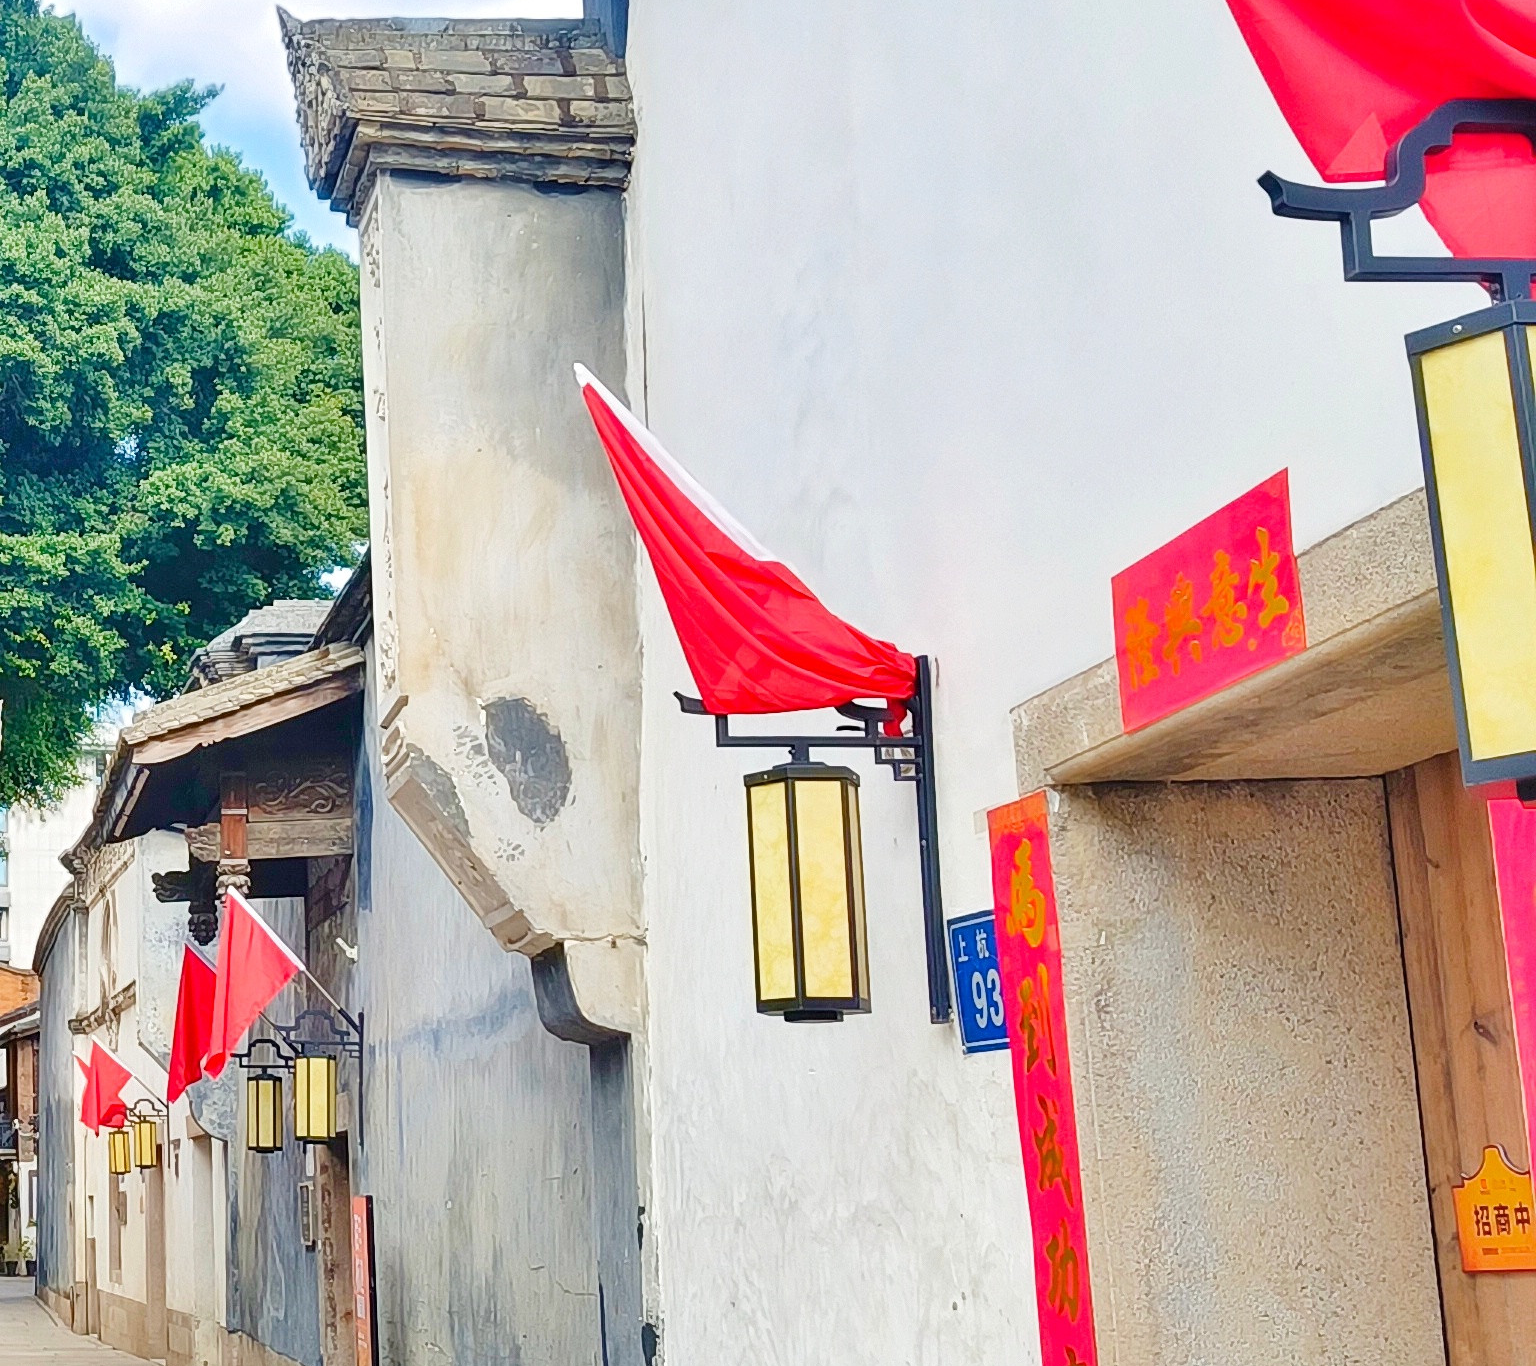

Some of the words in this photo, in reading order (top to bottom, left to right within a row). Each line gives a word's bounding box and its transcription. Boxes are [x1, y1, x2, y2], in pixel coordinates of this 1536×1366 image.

[971, 968, 1005, 1029] 93
[1473, 1201, 1531, 1236] 招商中
